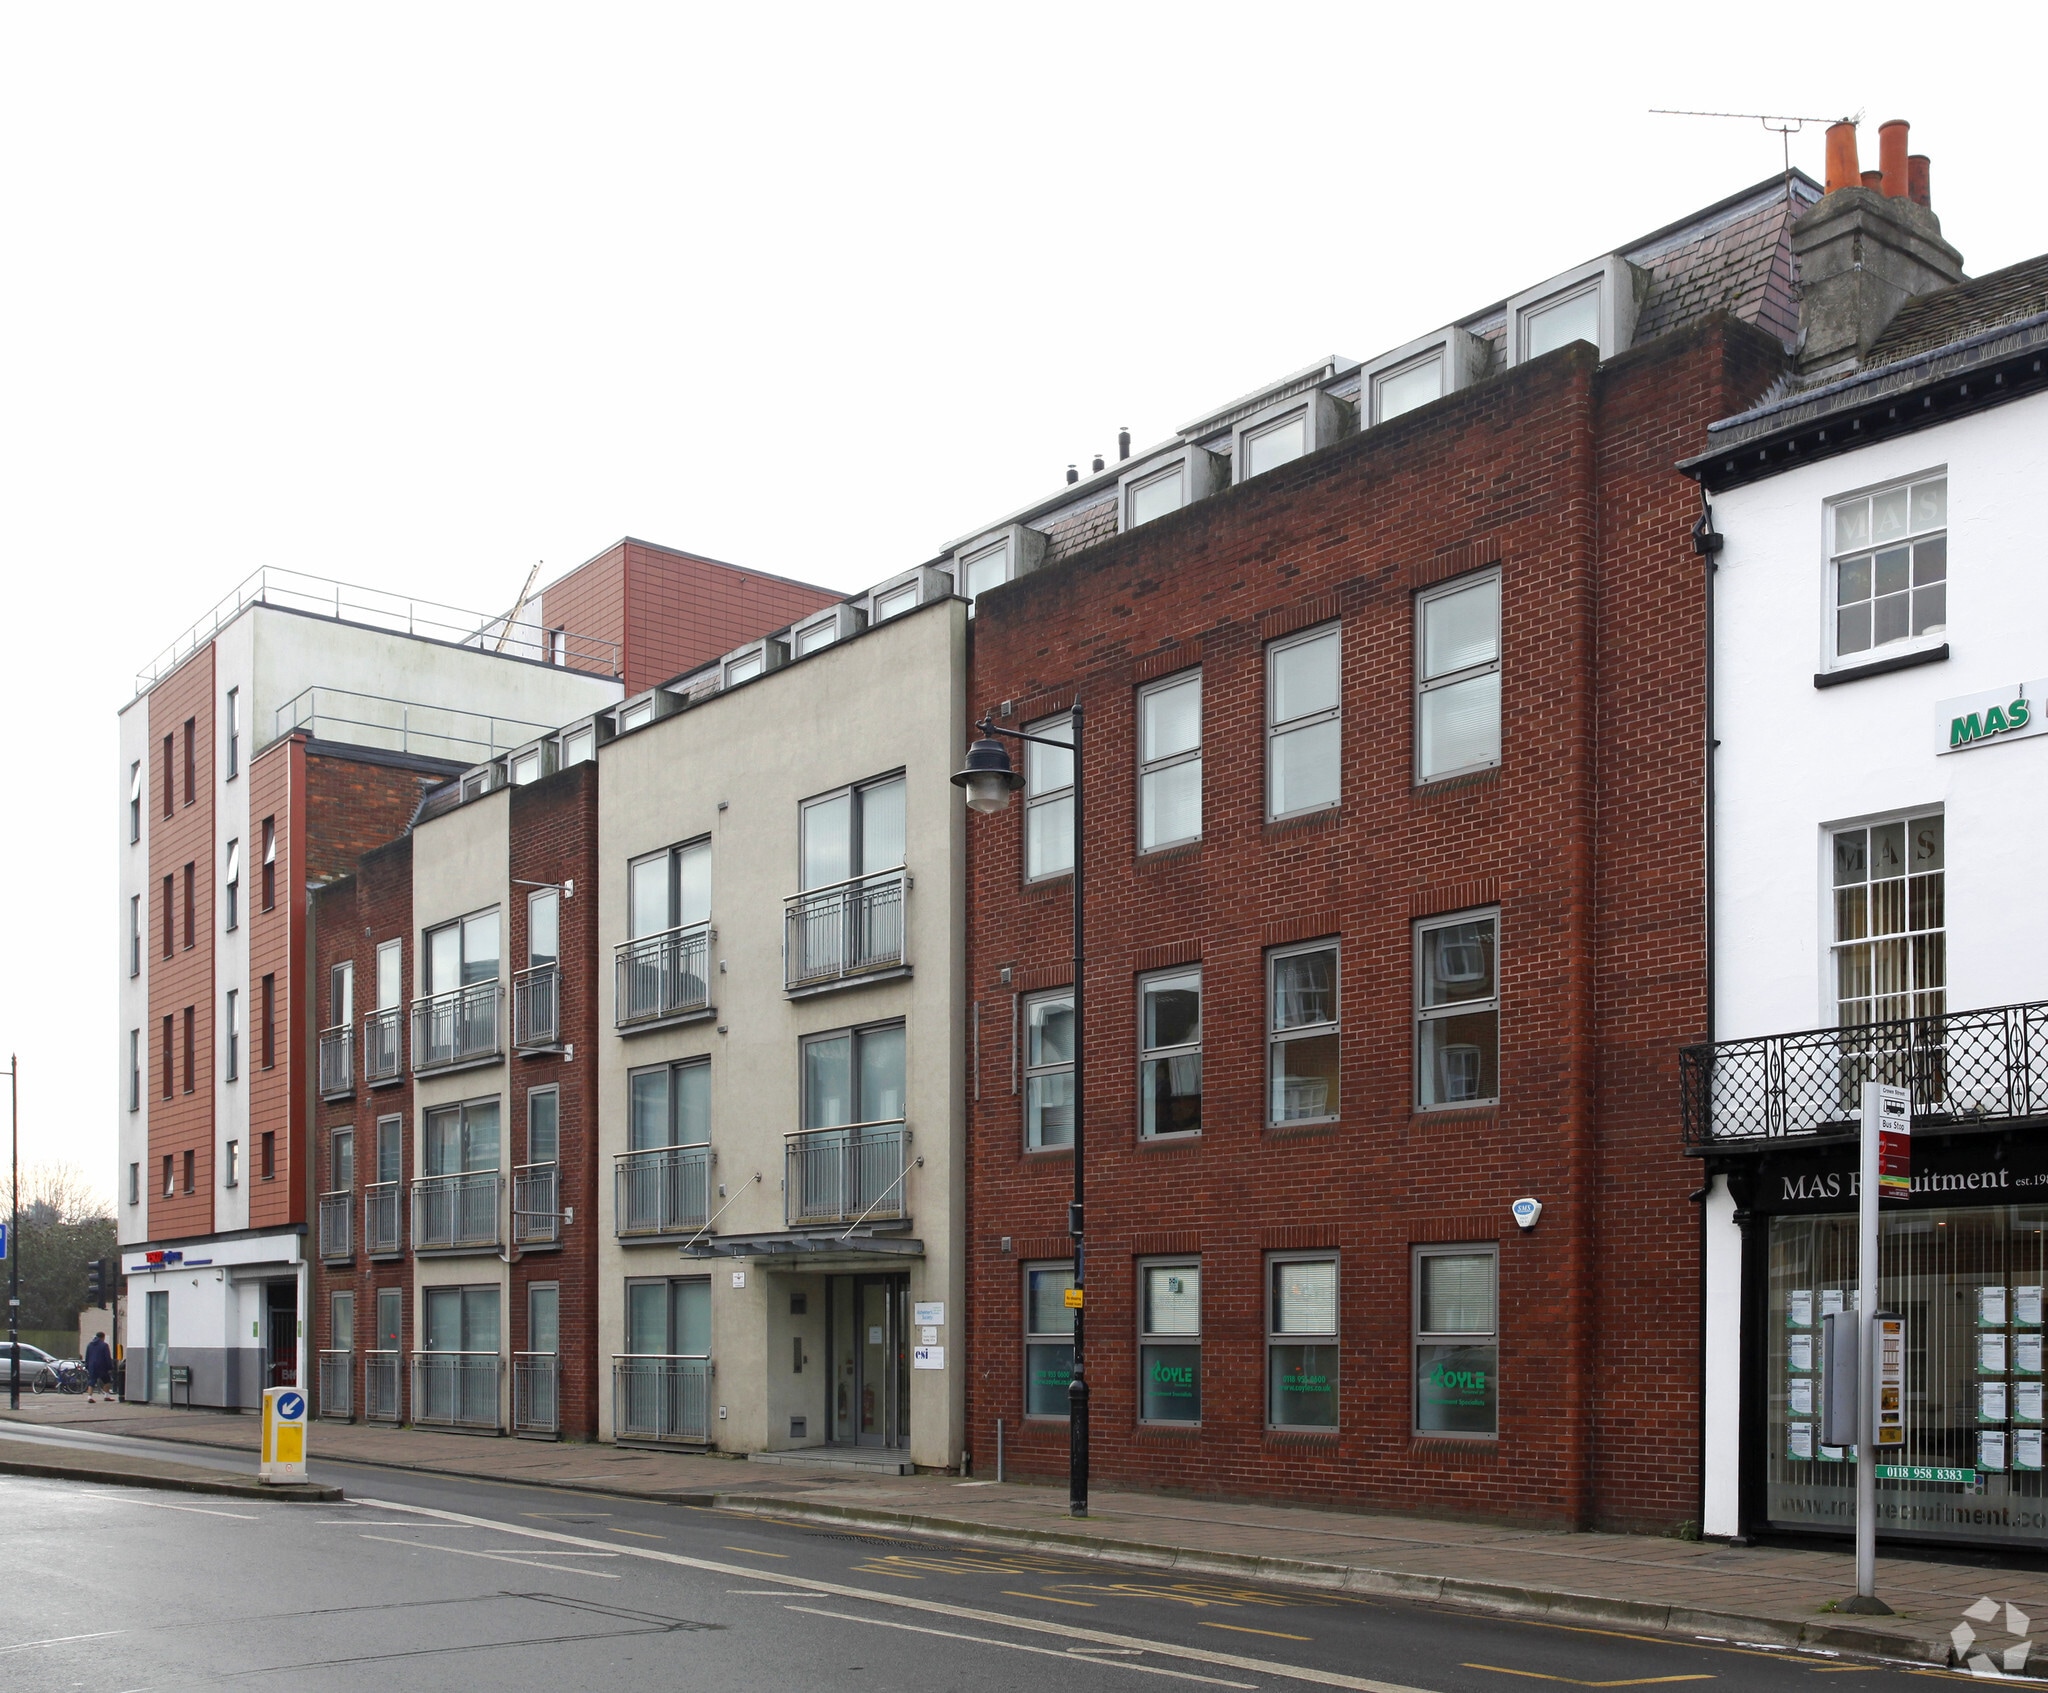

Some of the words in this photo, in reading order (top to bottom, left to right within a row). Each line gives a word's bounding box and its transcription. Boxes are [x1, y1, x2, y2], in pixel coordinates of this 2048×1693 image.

[1840, 491, 1938, 542] MAS
[1948, 698, 2031, 748] MAS
[1882, 1119, 1892, 1129] Bus
[1893, 1121, 1905, 1131] Stop
[1781, 1172, 1841, 1200] MAS
[1848, 1167, 2009, 1197] Ruitment
[916, 1348, 928, 1359] esi
[1154, 1366, 1192, 1383] COYLE
[1434, 1369, 1485, 1389] COYLE
[1886, 1466, 1909, 1478] 0118
[1913, 1468, 1932, 1479] 958
[1936, 1469, 1962, 1480] 8383
[1779, 1495, 2048, 1530] www.marecruitment.co
